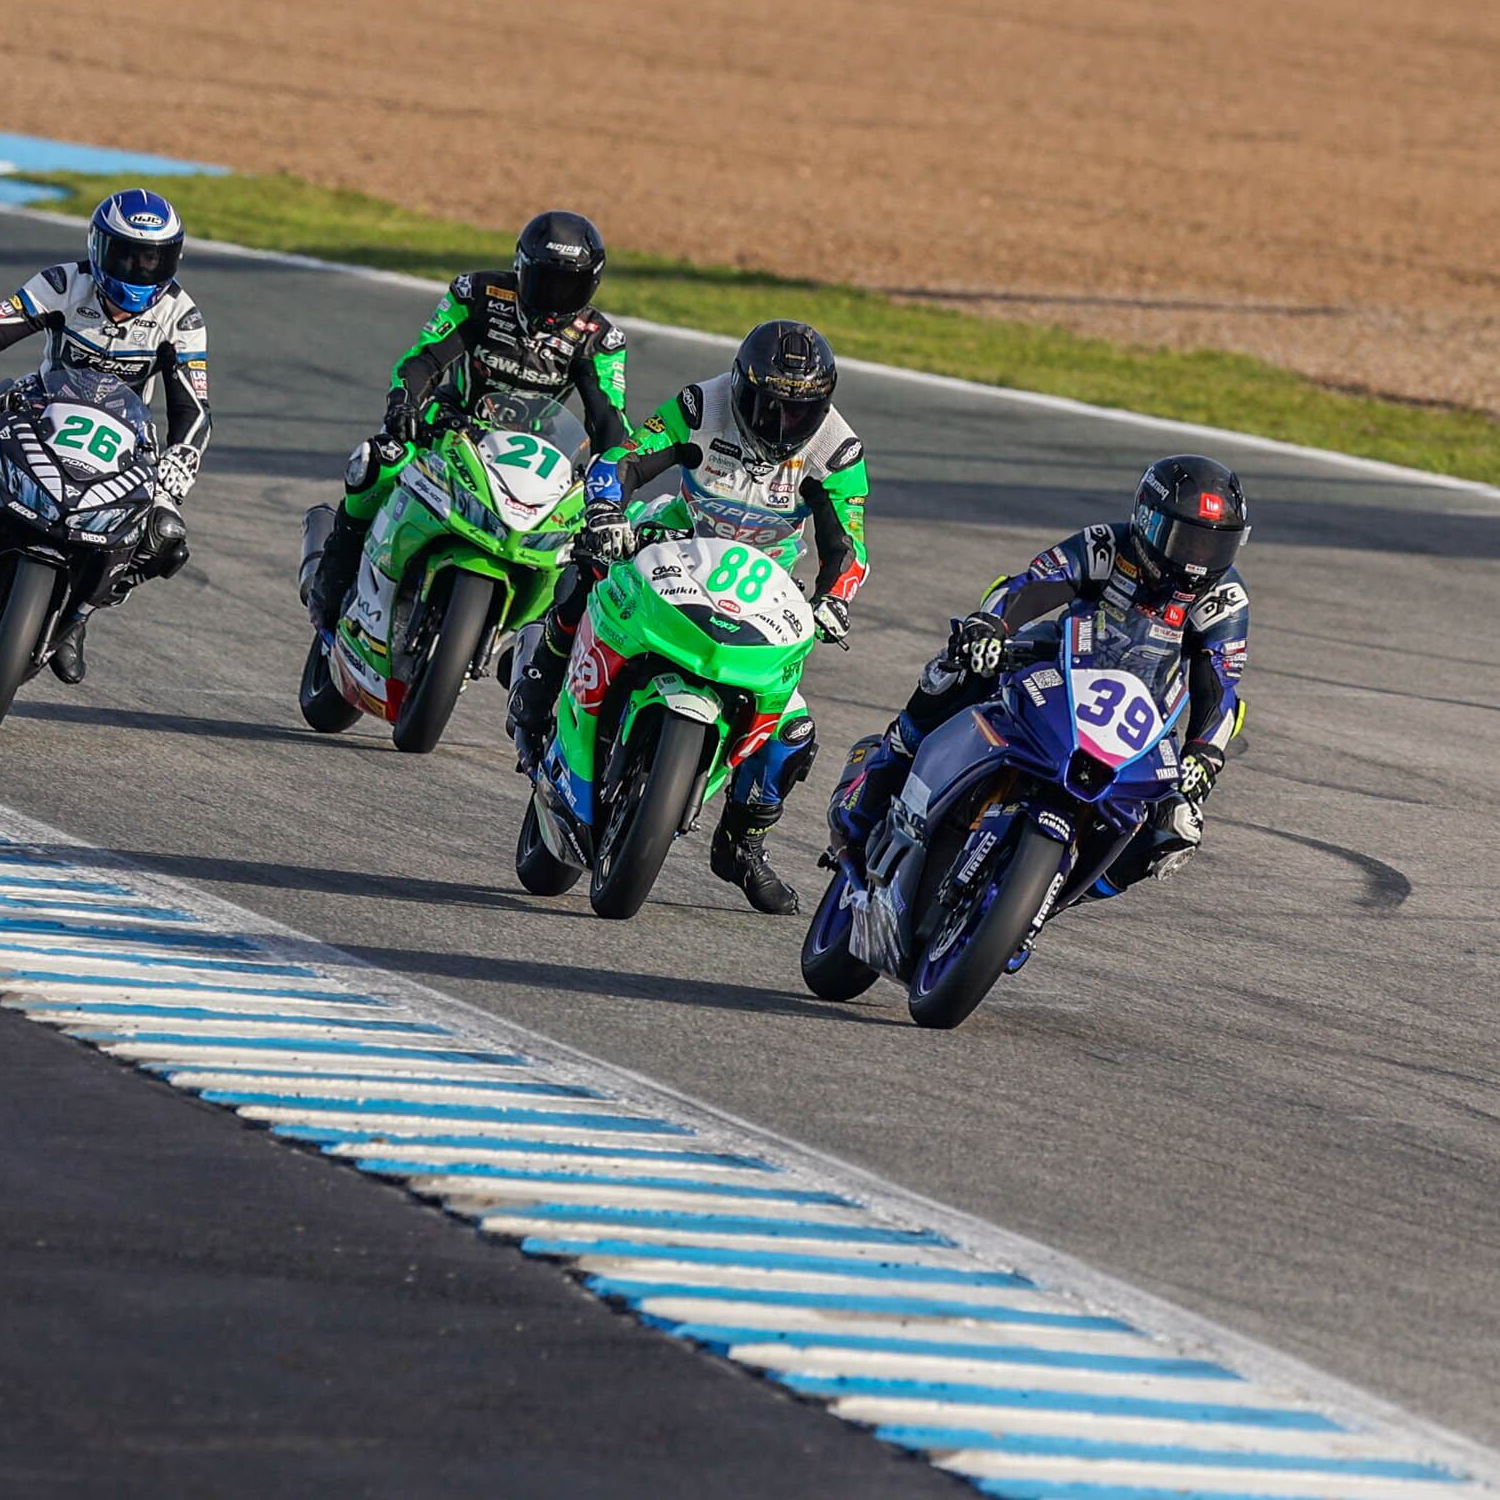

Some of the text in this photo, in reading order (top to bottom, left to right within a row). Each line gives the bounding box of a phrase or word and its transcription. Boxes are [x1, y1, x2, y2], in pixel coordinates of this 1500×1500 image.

[53, 415, 123, 463] 26
[494, 435, 562, 480] 21
[769, 482, 795, 494] MOTU
[706, 546, 773, 604] 88
[1021, 677, 1046, 707] YAMAHA
[1075, 677, 1156, 752] 39
[956, 830, 998, 885] PIRELLI
